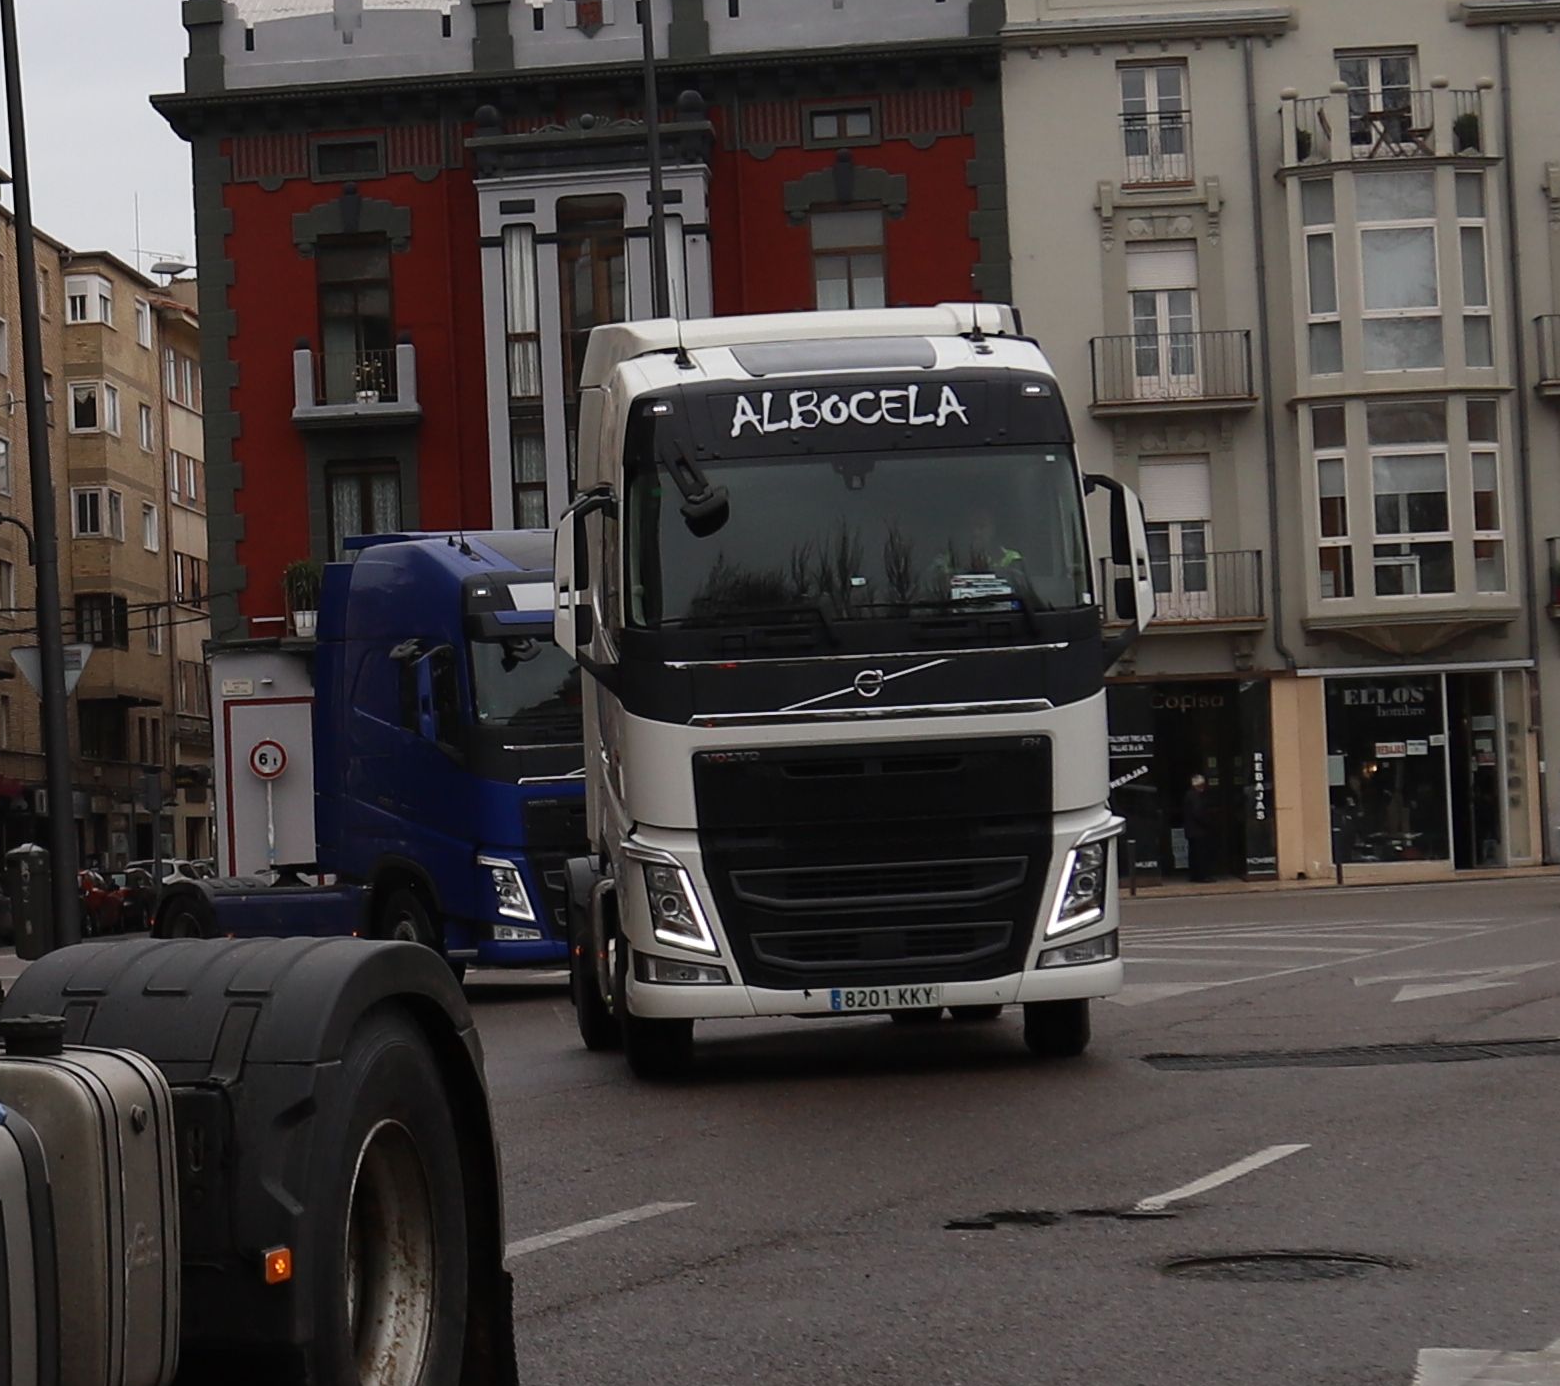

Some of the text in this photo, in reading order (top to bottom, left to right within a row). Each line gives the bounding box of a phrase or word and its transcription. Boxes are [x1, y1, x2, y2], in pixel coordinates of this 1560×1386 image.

[731, 384, 970, 437] ALBOCELA
[1343, 686, 1425, 706] ELLOS
[1376, 705, 1426, 717] hombre
[259, 753, 268, 766] 6
[1253, 752, 1265, 820] REBAJAS
[845, 987, 933, 1008] 8201 KKY
